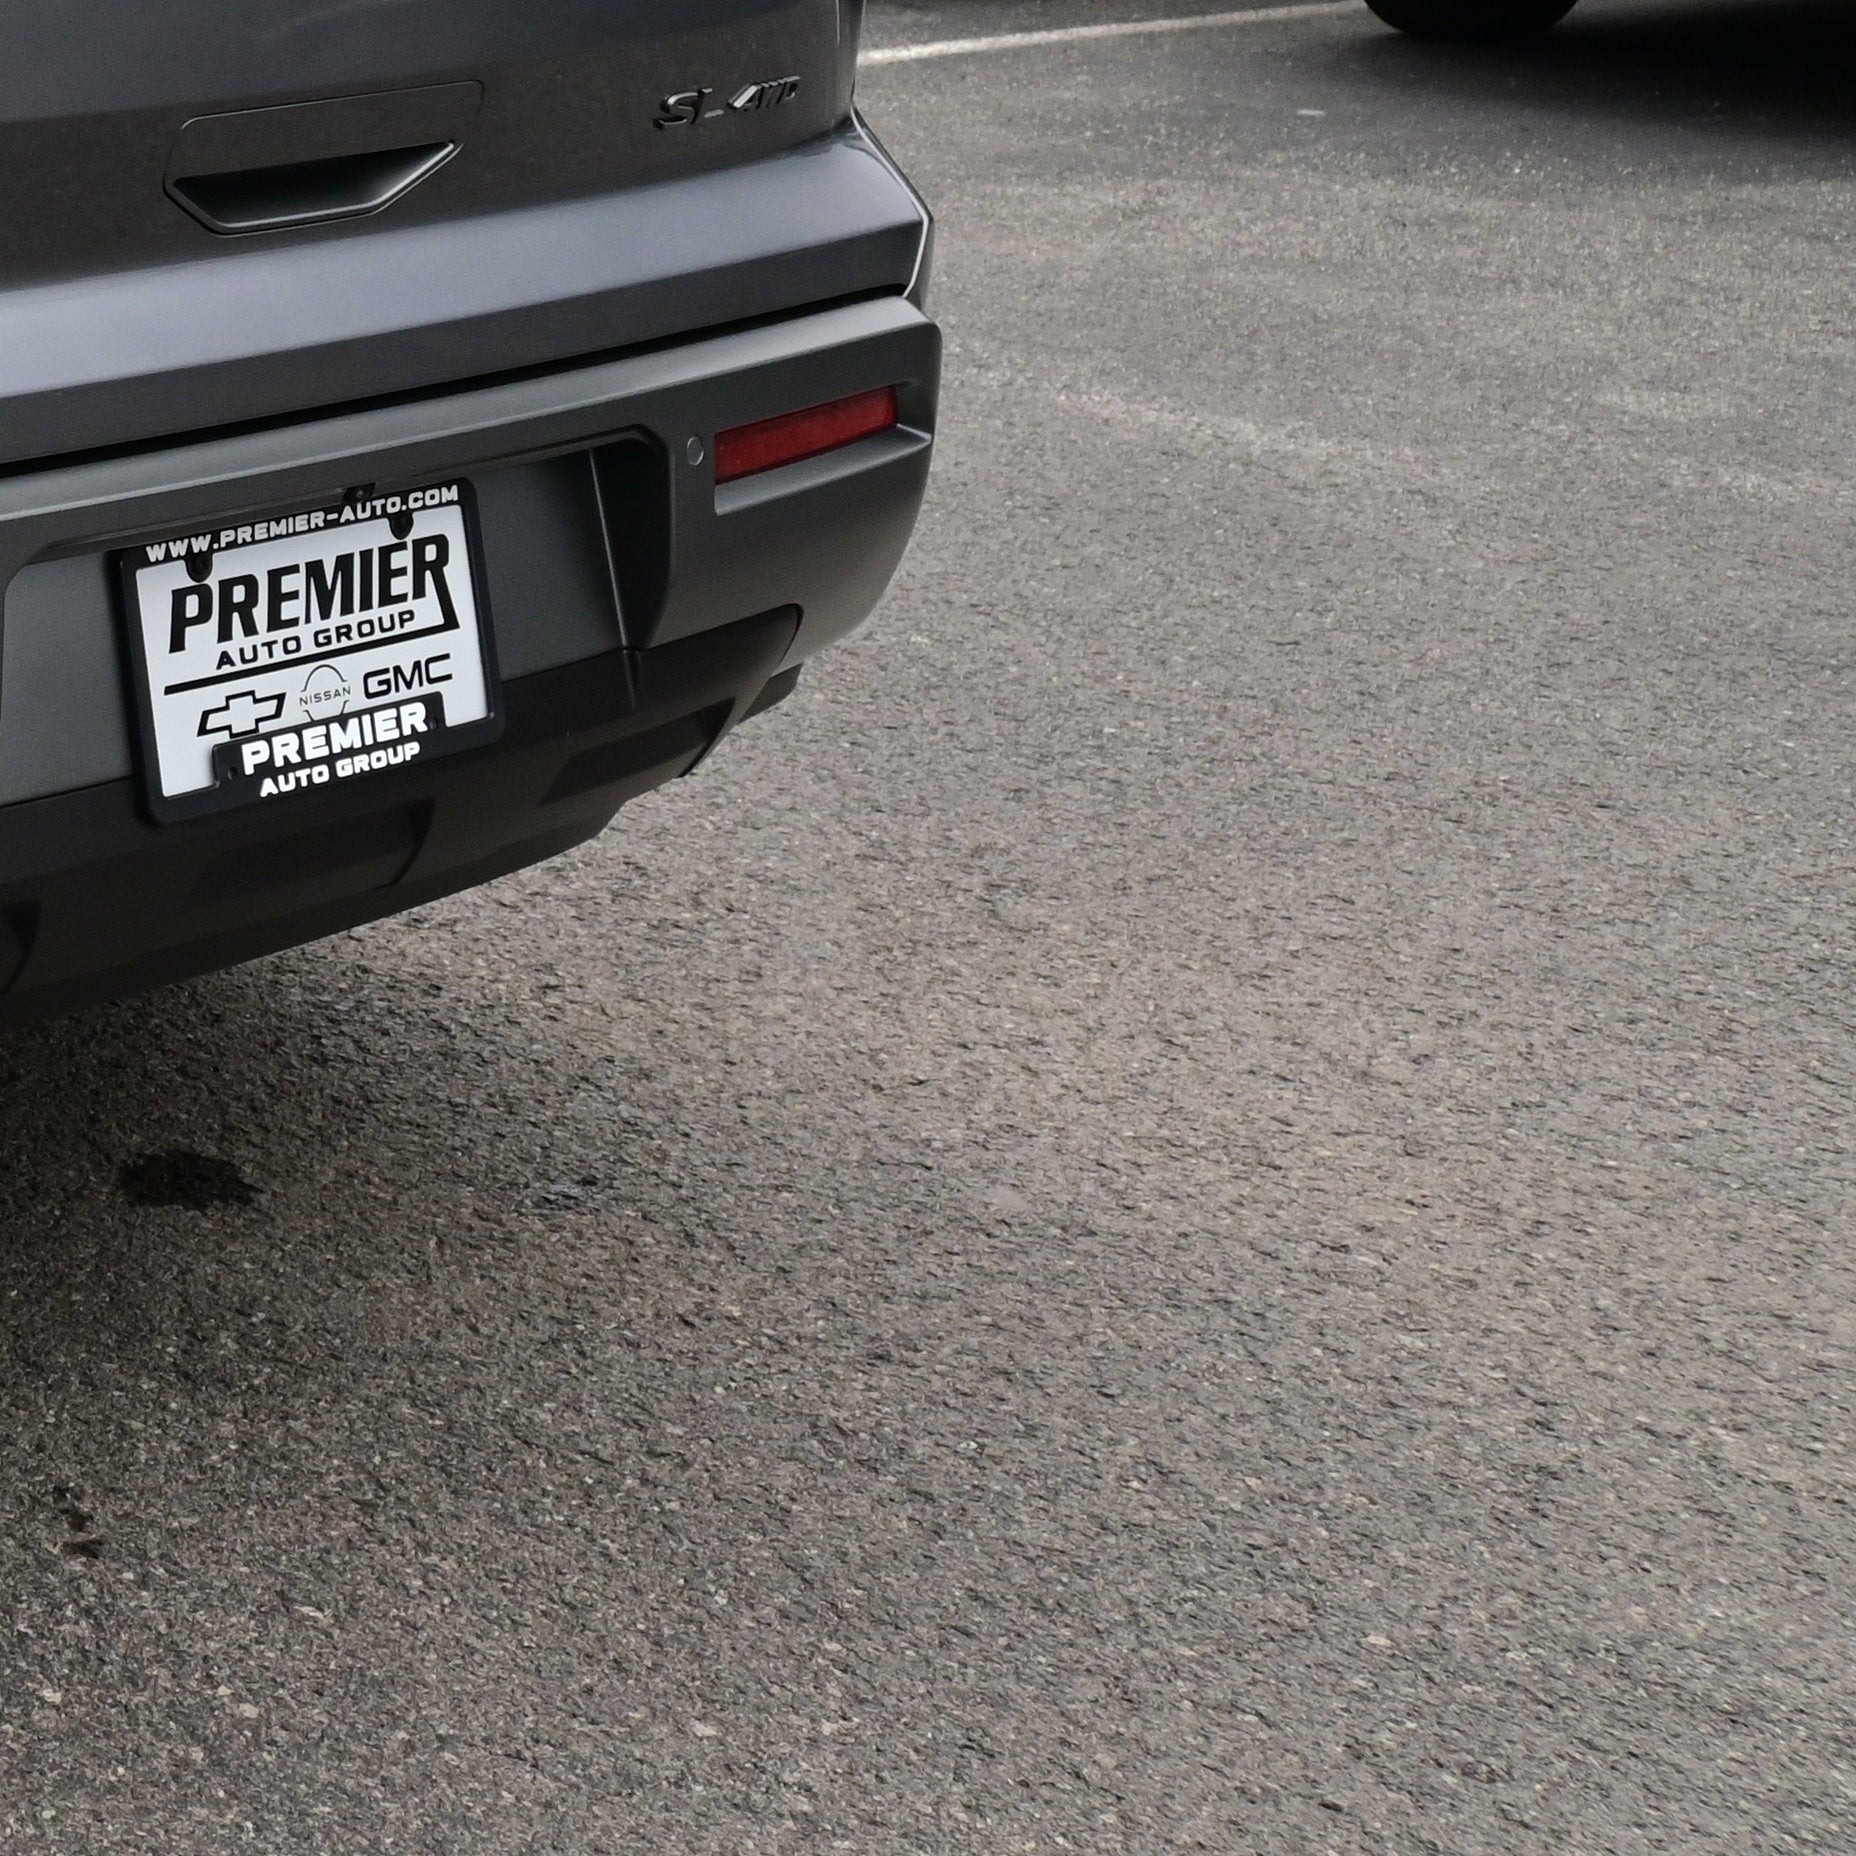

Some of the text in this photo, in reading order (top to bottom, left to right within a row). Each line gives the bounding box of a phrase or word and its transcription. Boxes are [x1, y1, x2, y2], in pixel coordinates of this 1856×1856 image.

[145, 484, 459, 563] WWW.PREMIER-AUTO.COM
[168, 533, 461, 654] PREMIER
[215, 609, 416, 670] AUTO GROUP
[298, 685, 352, 707] NISSAN
[362, 653, 453, 700] GMC
[241, 701, 429, 776] PREMIER
[259, 741, 421, 798] AUTO GROUP
